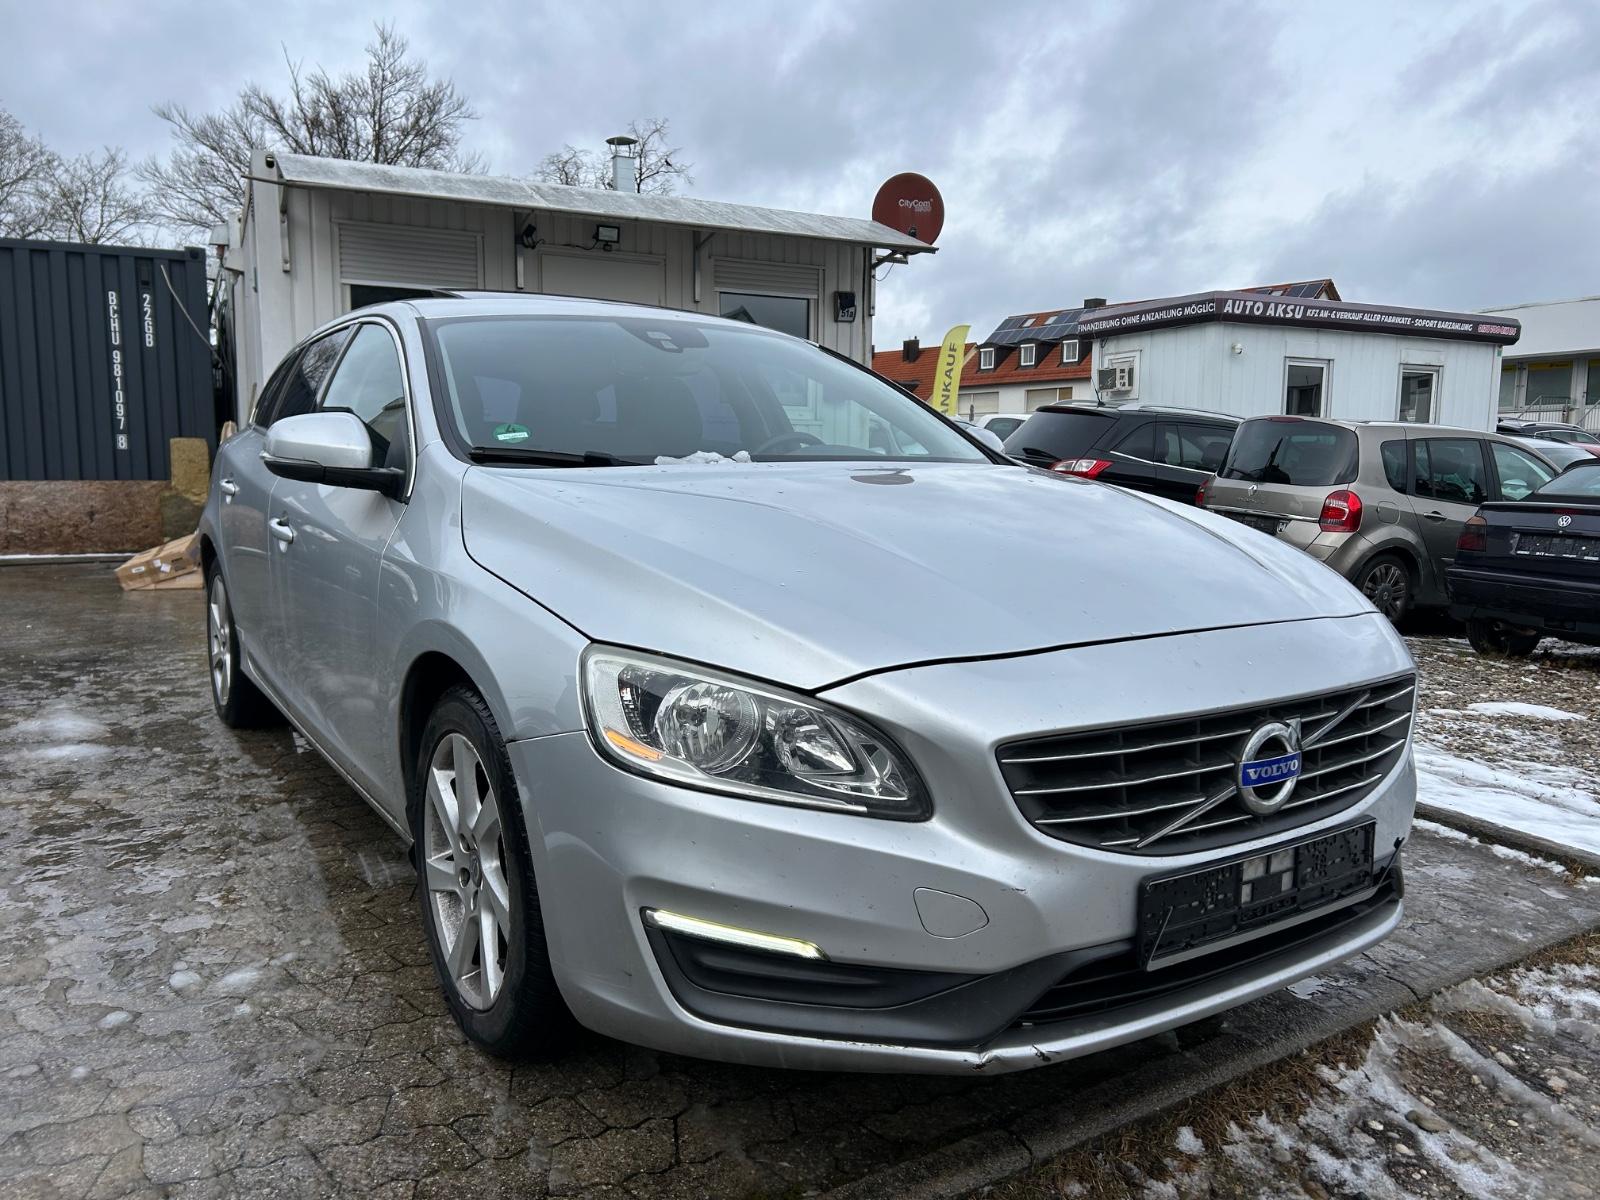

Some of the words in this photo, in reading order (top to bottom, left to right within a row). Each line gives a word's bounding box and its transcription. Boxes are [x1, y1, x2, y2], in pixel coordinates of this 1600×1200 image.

[898, 199, 931, 208] CityCom
[108, 291, 120, 345] BCHU
[1077, 318, 1121, 332] FINANZIERUNG
[1121, 315, 1140, 325] OHNE
[1140, 308, 1182, 322] ANZAHLUNG
[1183, 302, 1216, 315] MÖGLIC
[1224, 299, 1264, 315] AUTO
[1265, 302, 1304, 318] AKSU
[1306, 308, 1319, 317] KFZ
[1363, 313, 1381, 322] ALLER
[1381, 315, 1411, 325] FABRIKATE
[1414, 318, 1438, 327] SOFORT
[1437, 320, 1473, 331] BARZAHLUNG
[112, 349, 125, 430] 981097
[1246, 759, 1299, 780] VOLVO
